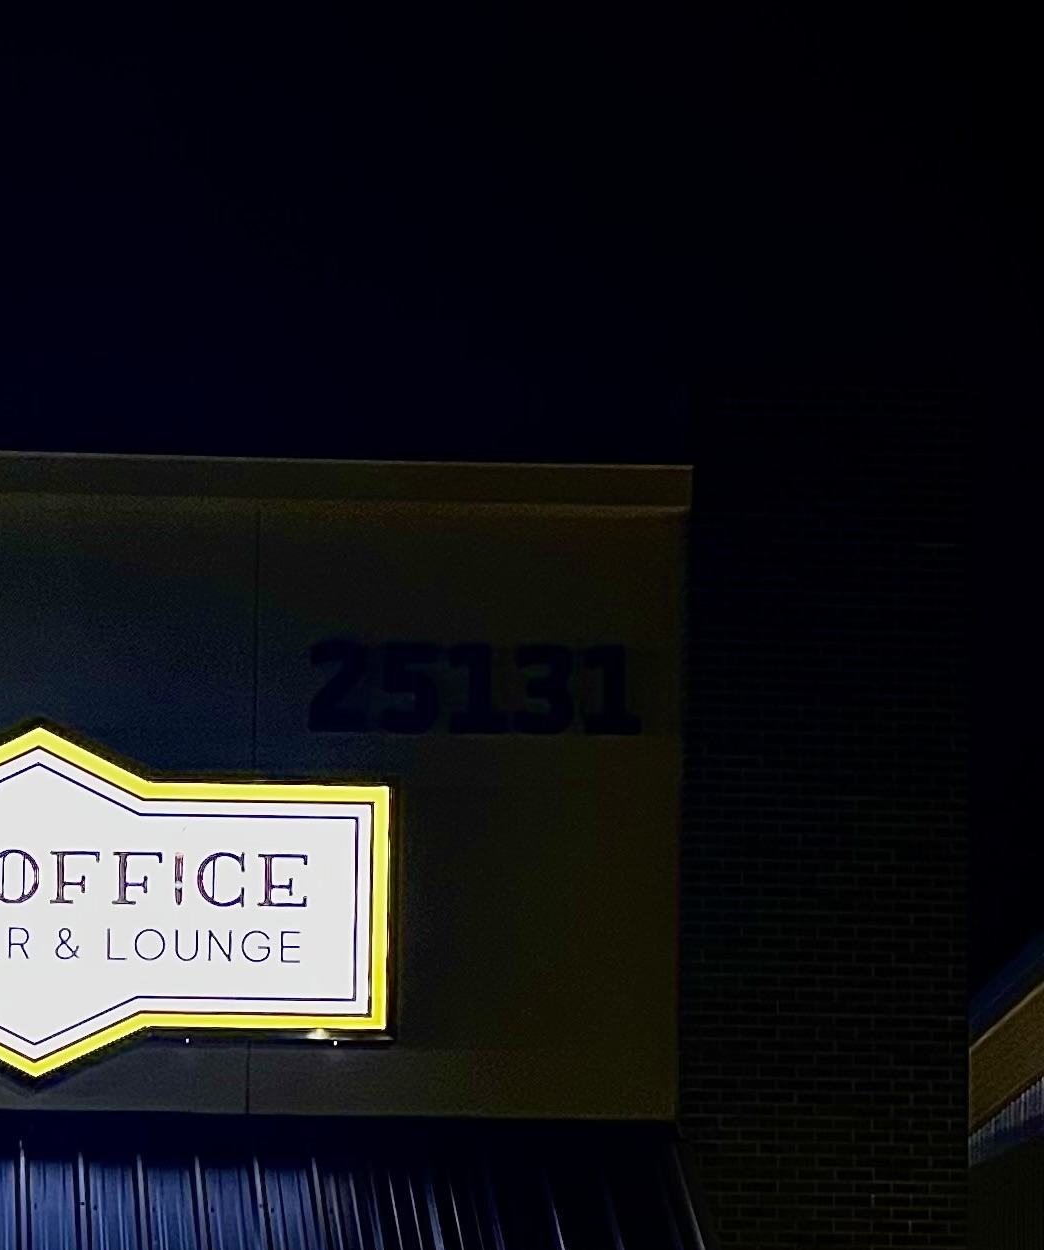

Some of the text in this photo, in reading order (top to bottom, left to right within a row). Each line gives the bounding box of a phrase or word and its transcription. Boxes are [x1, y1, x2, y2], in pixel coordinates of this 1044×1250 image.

[308, 638, 642, 735] 25131
[55, 926, 81, 961] &
[106, 929, 302, 965] LOUNGE
